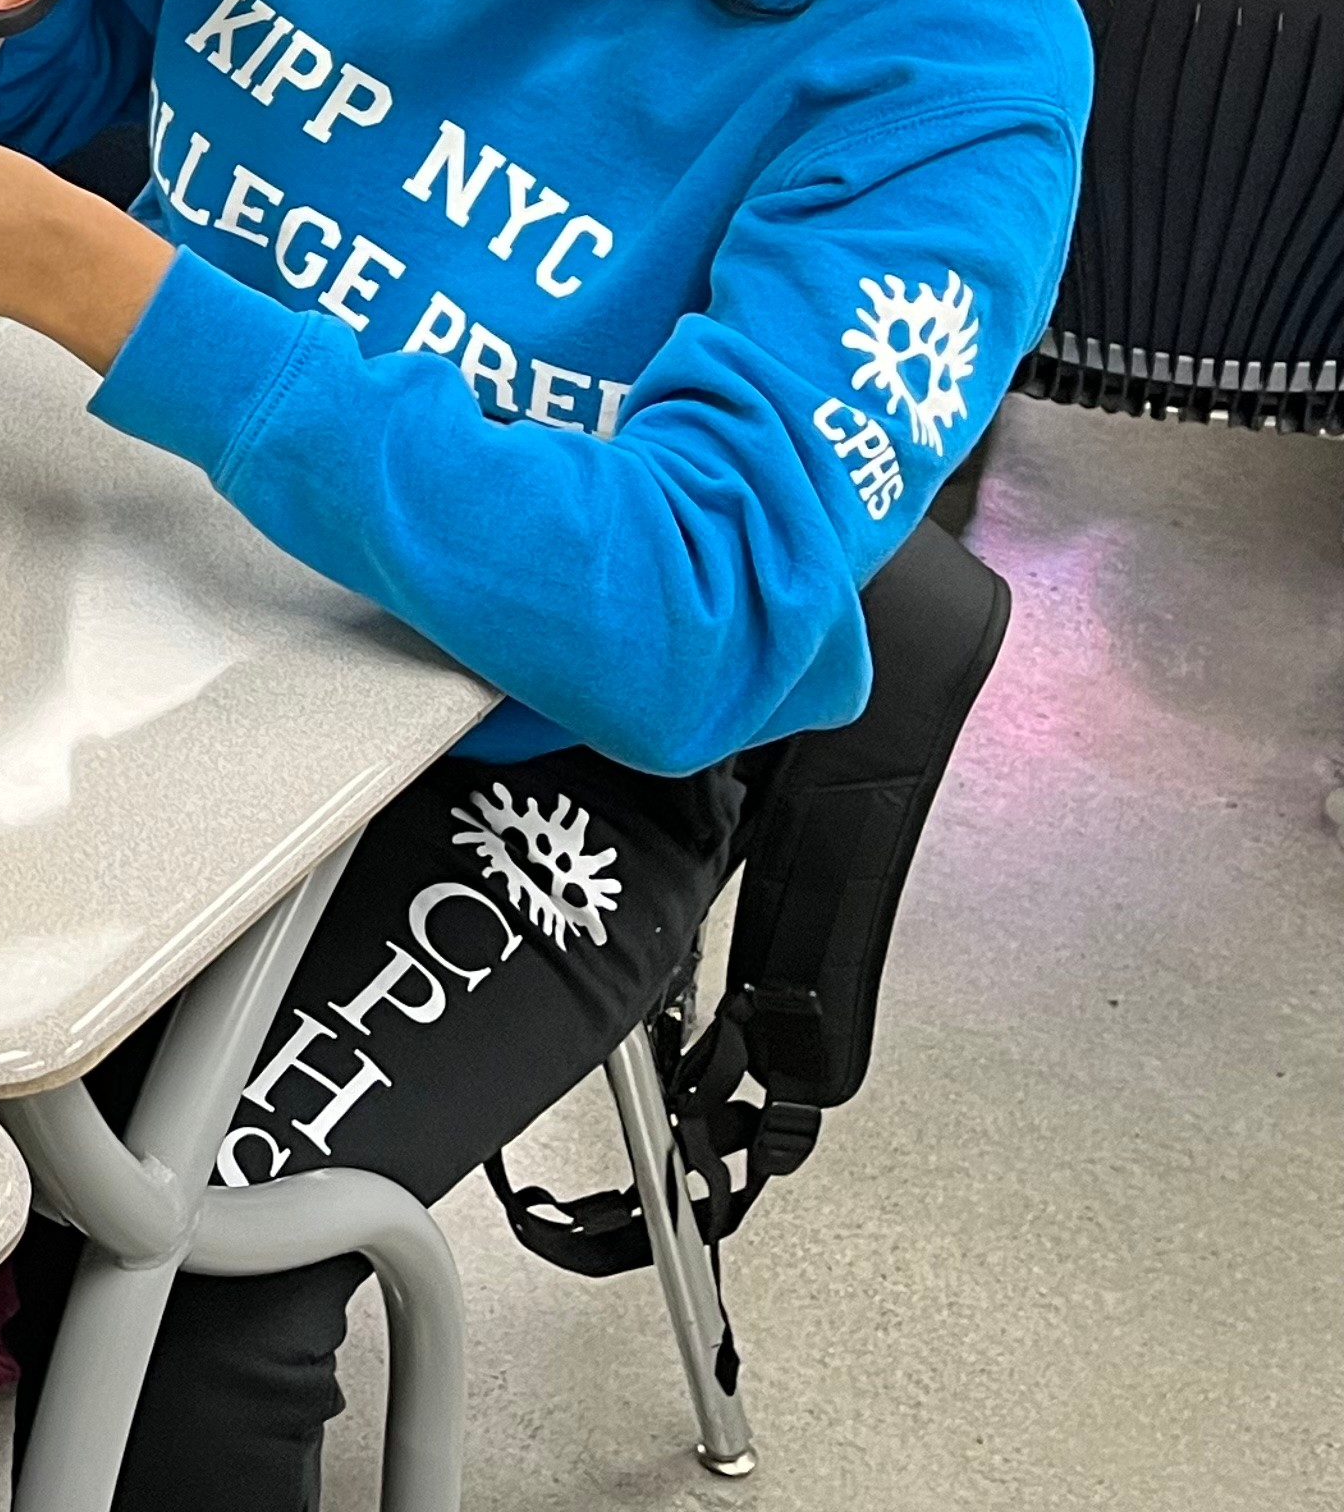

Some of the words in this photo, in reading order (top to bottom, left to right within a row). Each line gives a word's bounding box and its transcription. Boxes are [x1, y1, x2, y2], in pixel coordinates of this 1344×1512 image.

[150, 78, 407, 333] LLEGE
[402, 119, 613, 298] NYC
[813, 397, 904, 521] CPHS
